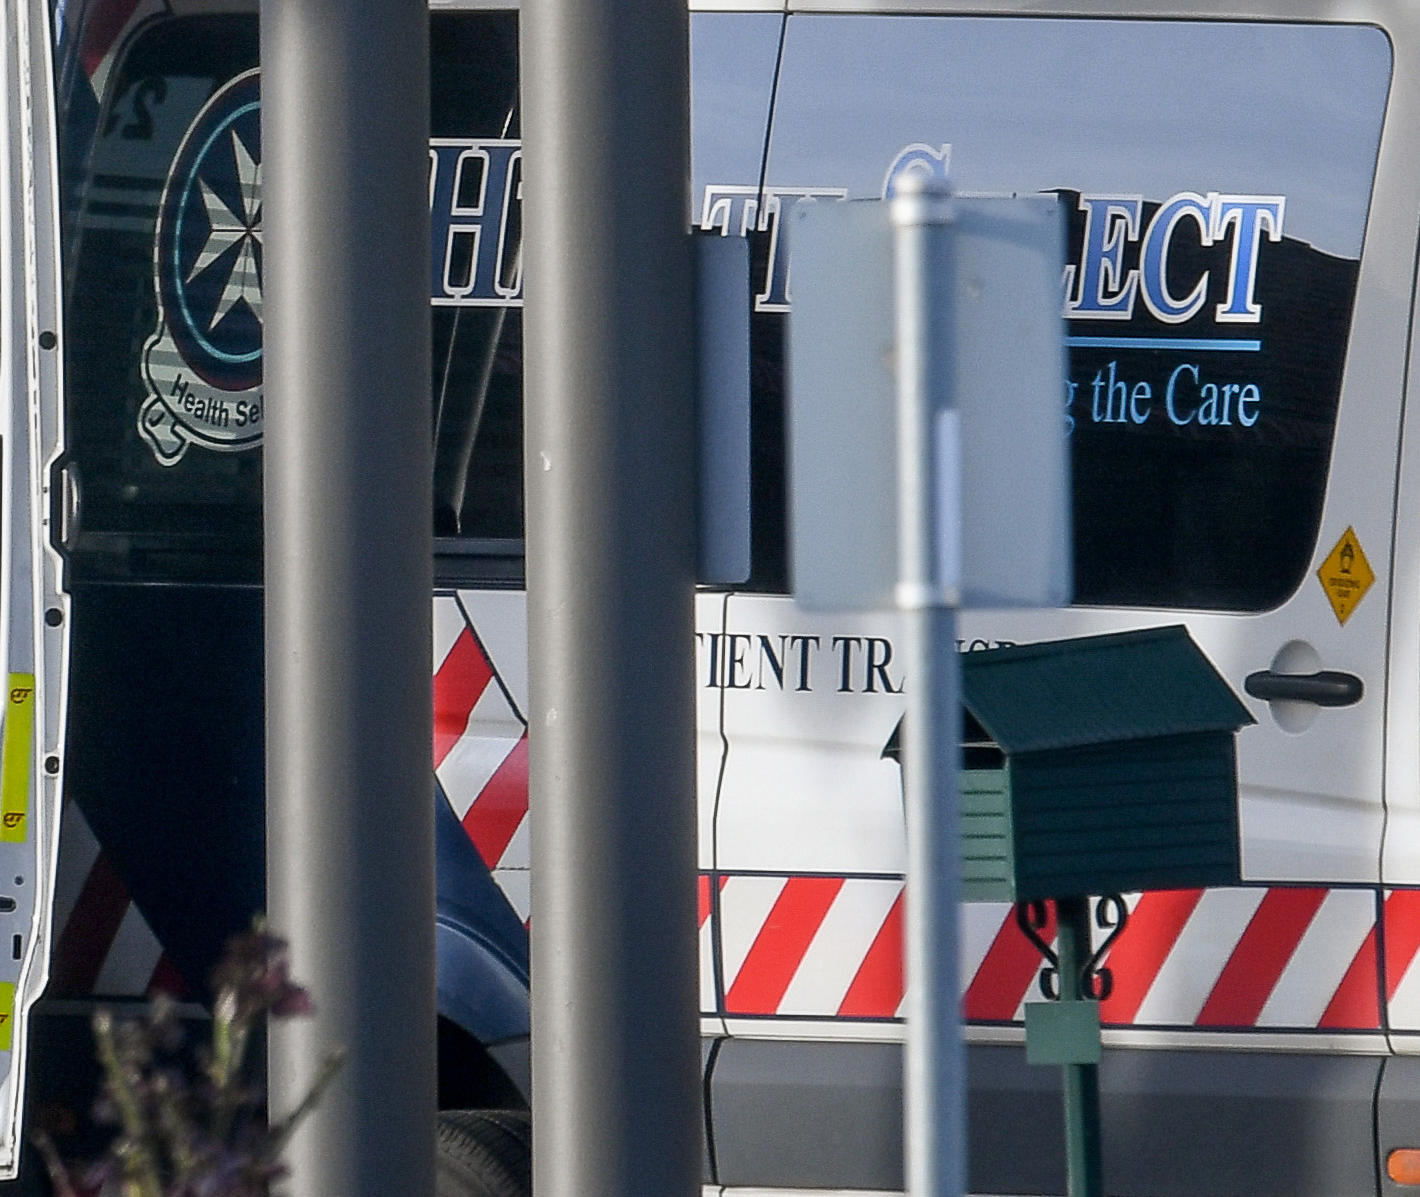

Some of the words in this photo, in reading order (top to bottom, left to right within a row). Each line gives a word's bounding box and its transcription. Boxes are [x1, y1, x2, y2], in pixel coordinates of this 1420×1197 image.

[171, 373, 230, 427] Health
[235, 394, 264, 427] Se
[1091, 360, 1152, 425] the
[1165, 363, 1261, 427] Care
